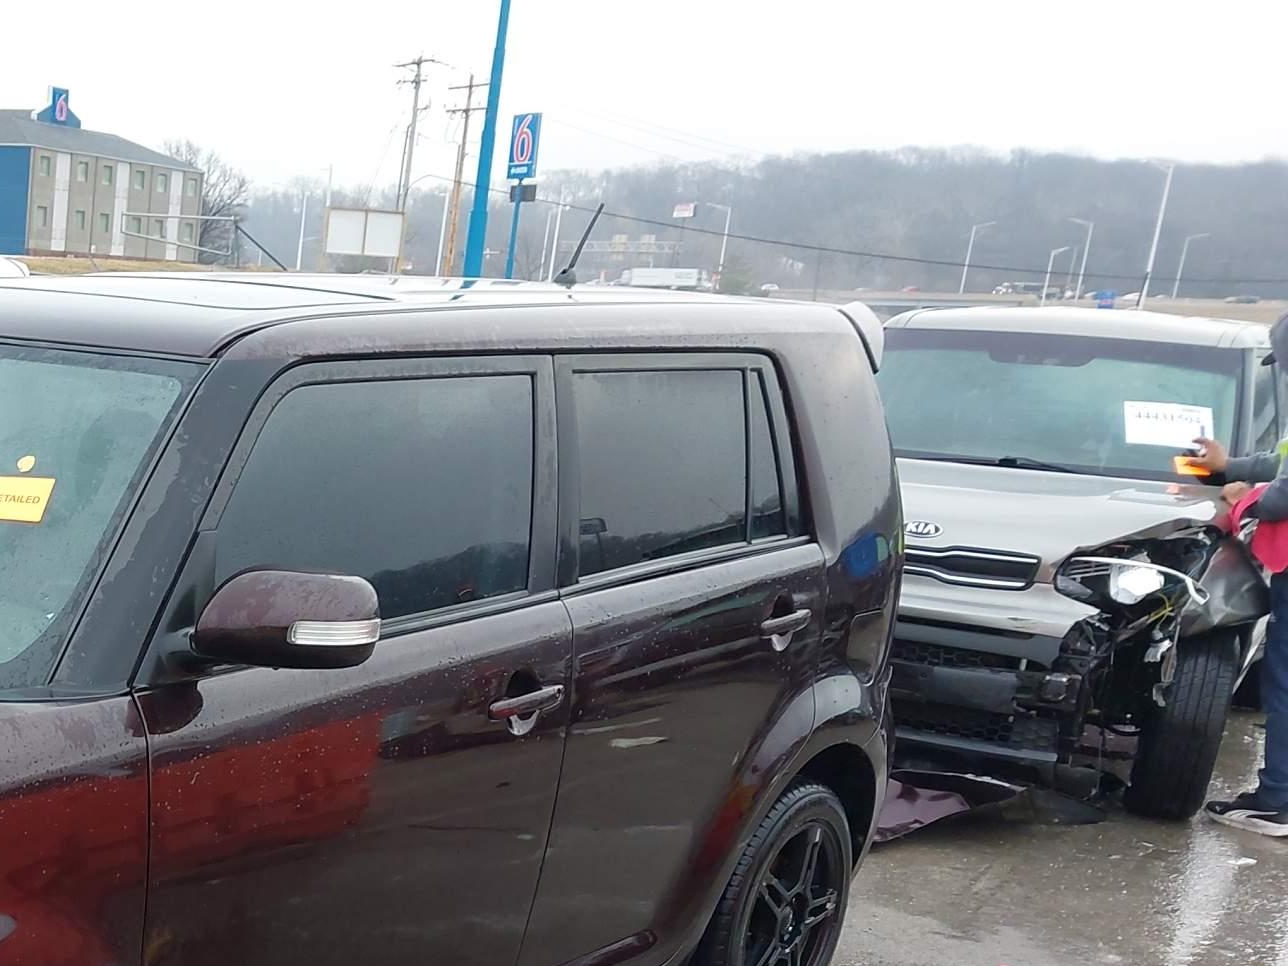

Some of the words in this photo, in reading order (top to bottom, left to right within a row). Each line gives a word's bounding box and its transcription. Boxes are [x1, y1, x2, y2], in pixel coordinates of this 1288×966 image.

[56, 94, 68, 121] 6
[514, 113, 532, 163] 6
[905, 522, 936, 534] KIA
